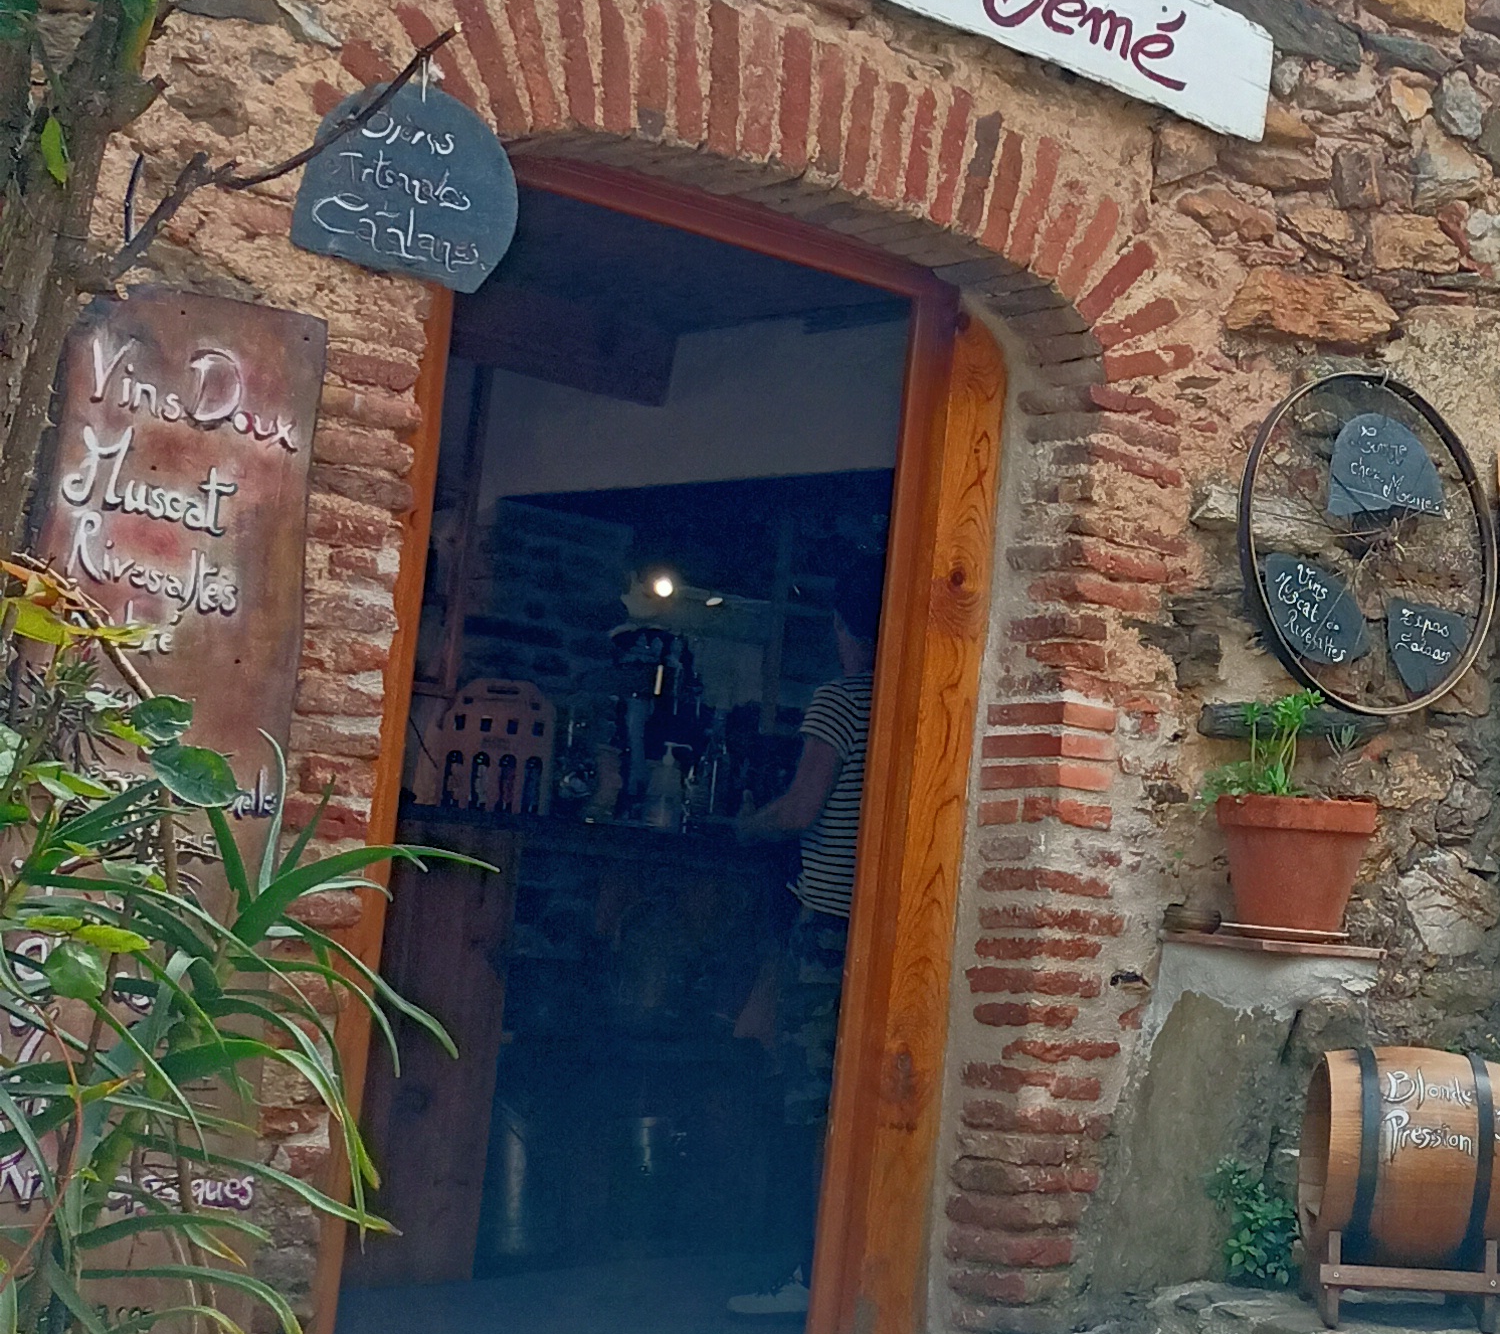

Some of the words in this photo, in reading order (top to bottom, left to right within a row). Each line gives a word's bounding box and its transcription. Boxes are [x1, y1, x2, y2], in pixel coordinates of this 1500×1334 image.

[90, 337, 181, 421] Vins
[184, 346, 298, 452] Doux
[61, 424, 237, 536] Muscat
[66, 511, 239, 615] Rivesaltes
[1296, 563, 1329, 601] Vins
[1275, 571, 1318, 624] Muscat
[1382, 1066, 1474, 1111] Blonde
[1381, 1108, 1475, 1164] Pression
